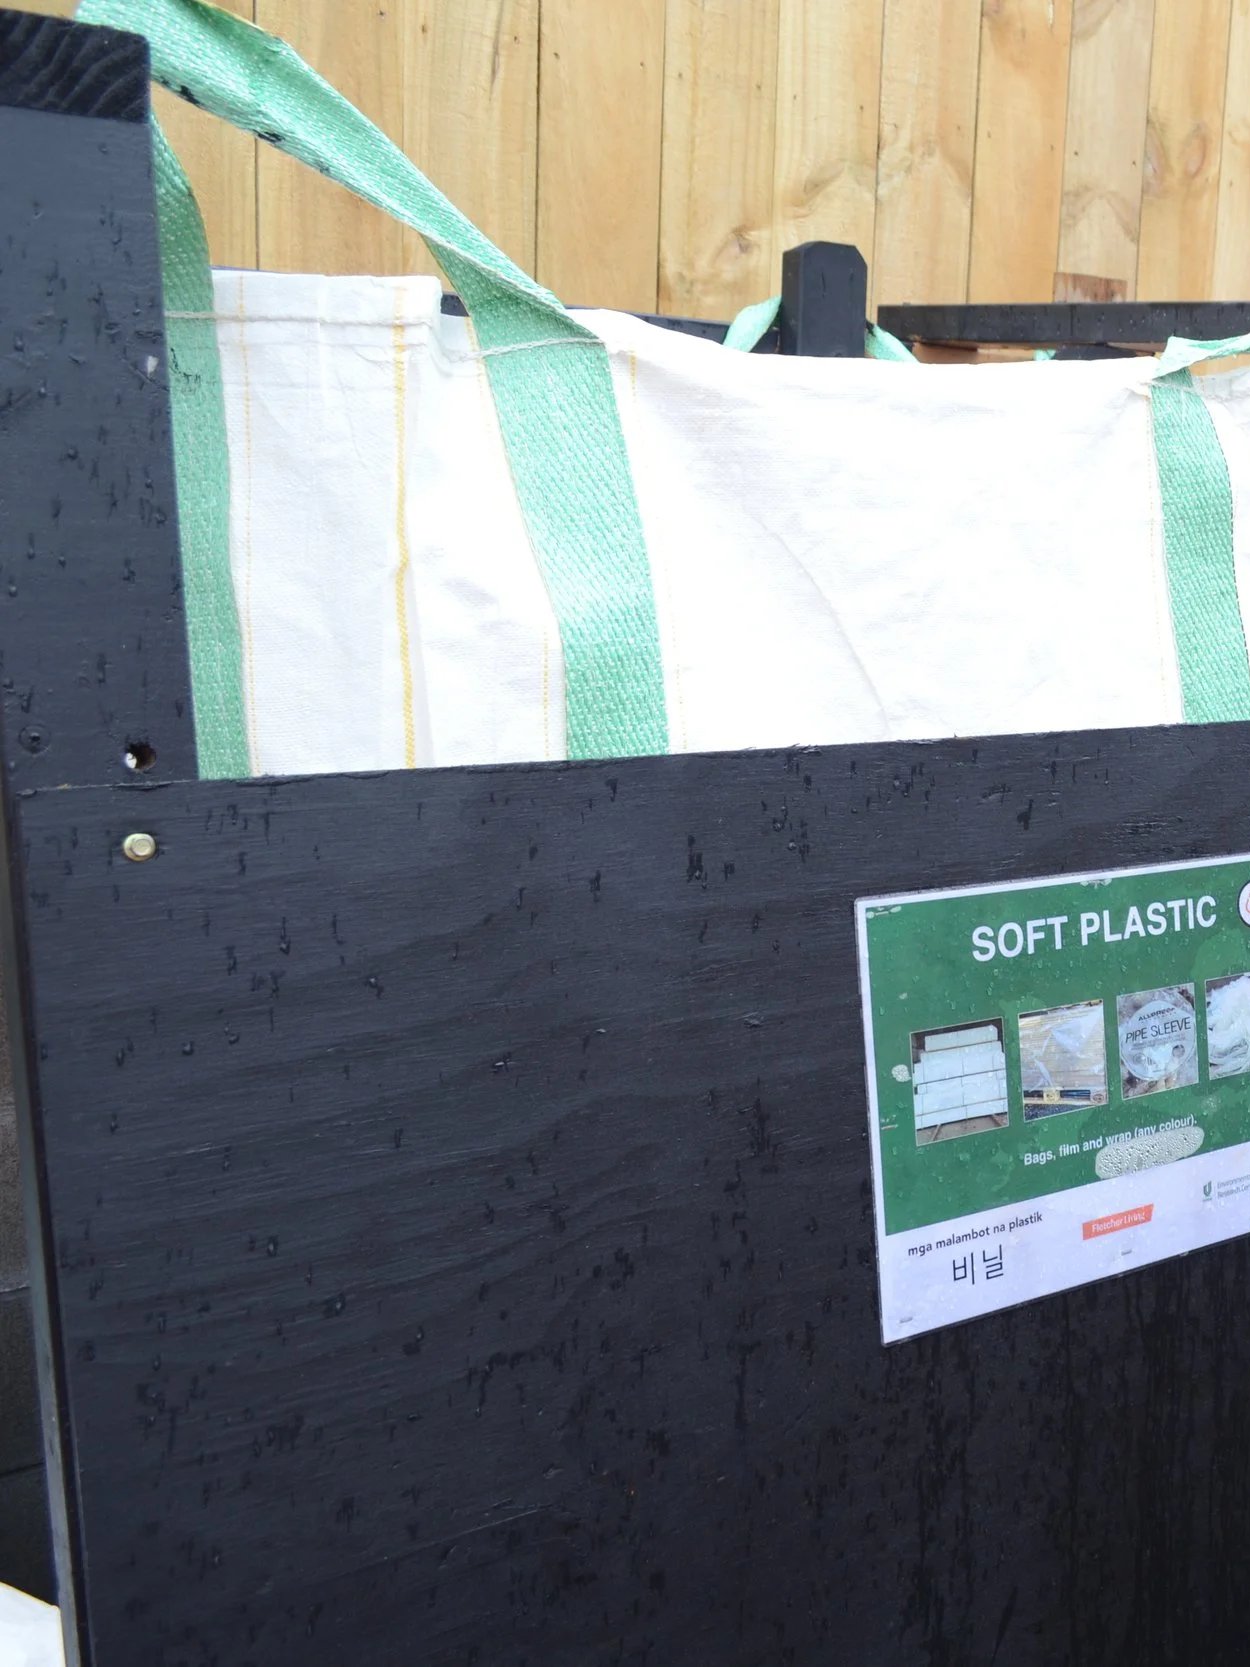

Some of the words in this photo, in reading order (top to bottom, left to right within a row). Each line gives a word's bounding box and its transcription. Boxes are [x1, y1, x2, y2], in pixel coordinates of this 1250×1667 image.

[971, 915, 1068, 962] SOFT
[1080, 895, 1217, 946] PLASTIC
[1125, 1027, 1148, 1043] PIPE
[1150, 1017, 1192, 1037] SLEEVE
[1024, 1151, 1056, 1166] Bags,
[1059, 1144, 1080, 1157] film
[1083, 1136, 1103, 1151] and
[1105, 1130, 1132, 1145] wrap
[1159, 1114, 1197, 1132] colour).
[908, 1243, 933, 1256] mga
[936, 1227, 990, 1249] malambot
[993, 1223, 1006, 1234] na
[1009, 1211, 1043, 1232] plastik
[1091, 1218, 1123, 1233] Fletcher
[1124, 1211, 1146, 1226] Living
[952, 1244, 1004, 1285] 비닐
